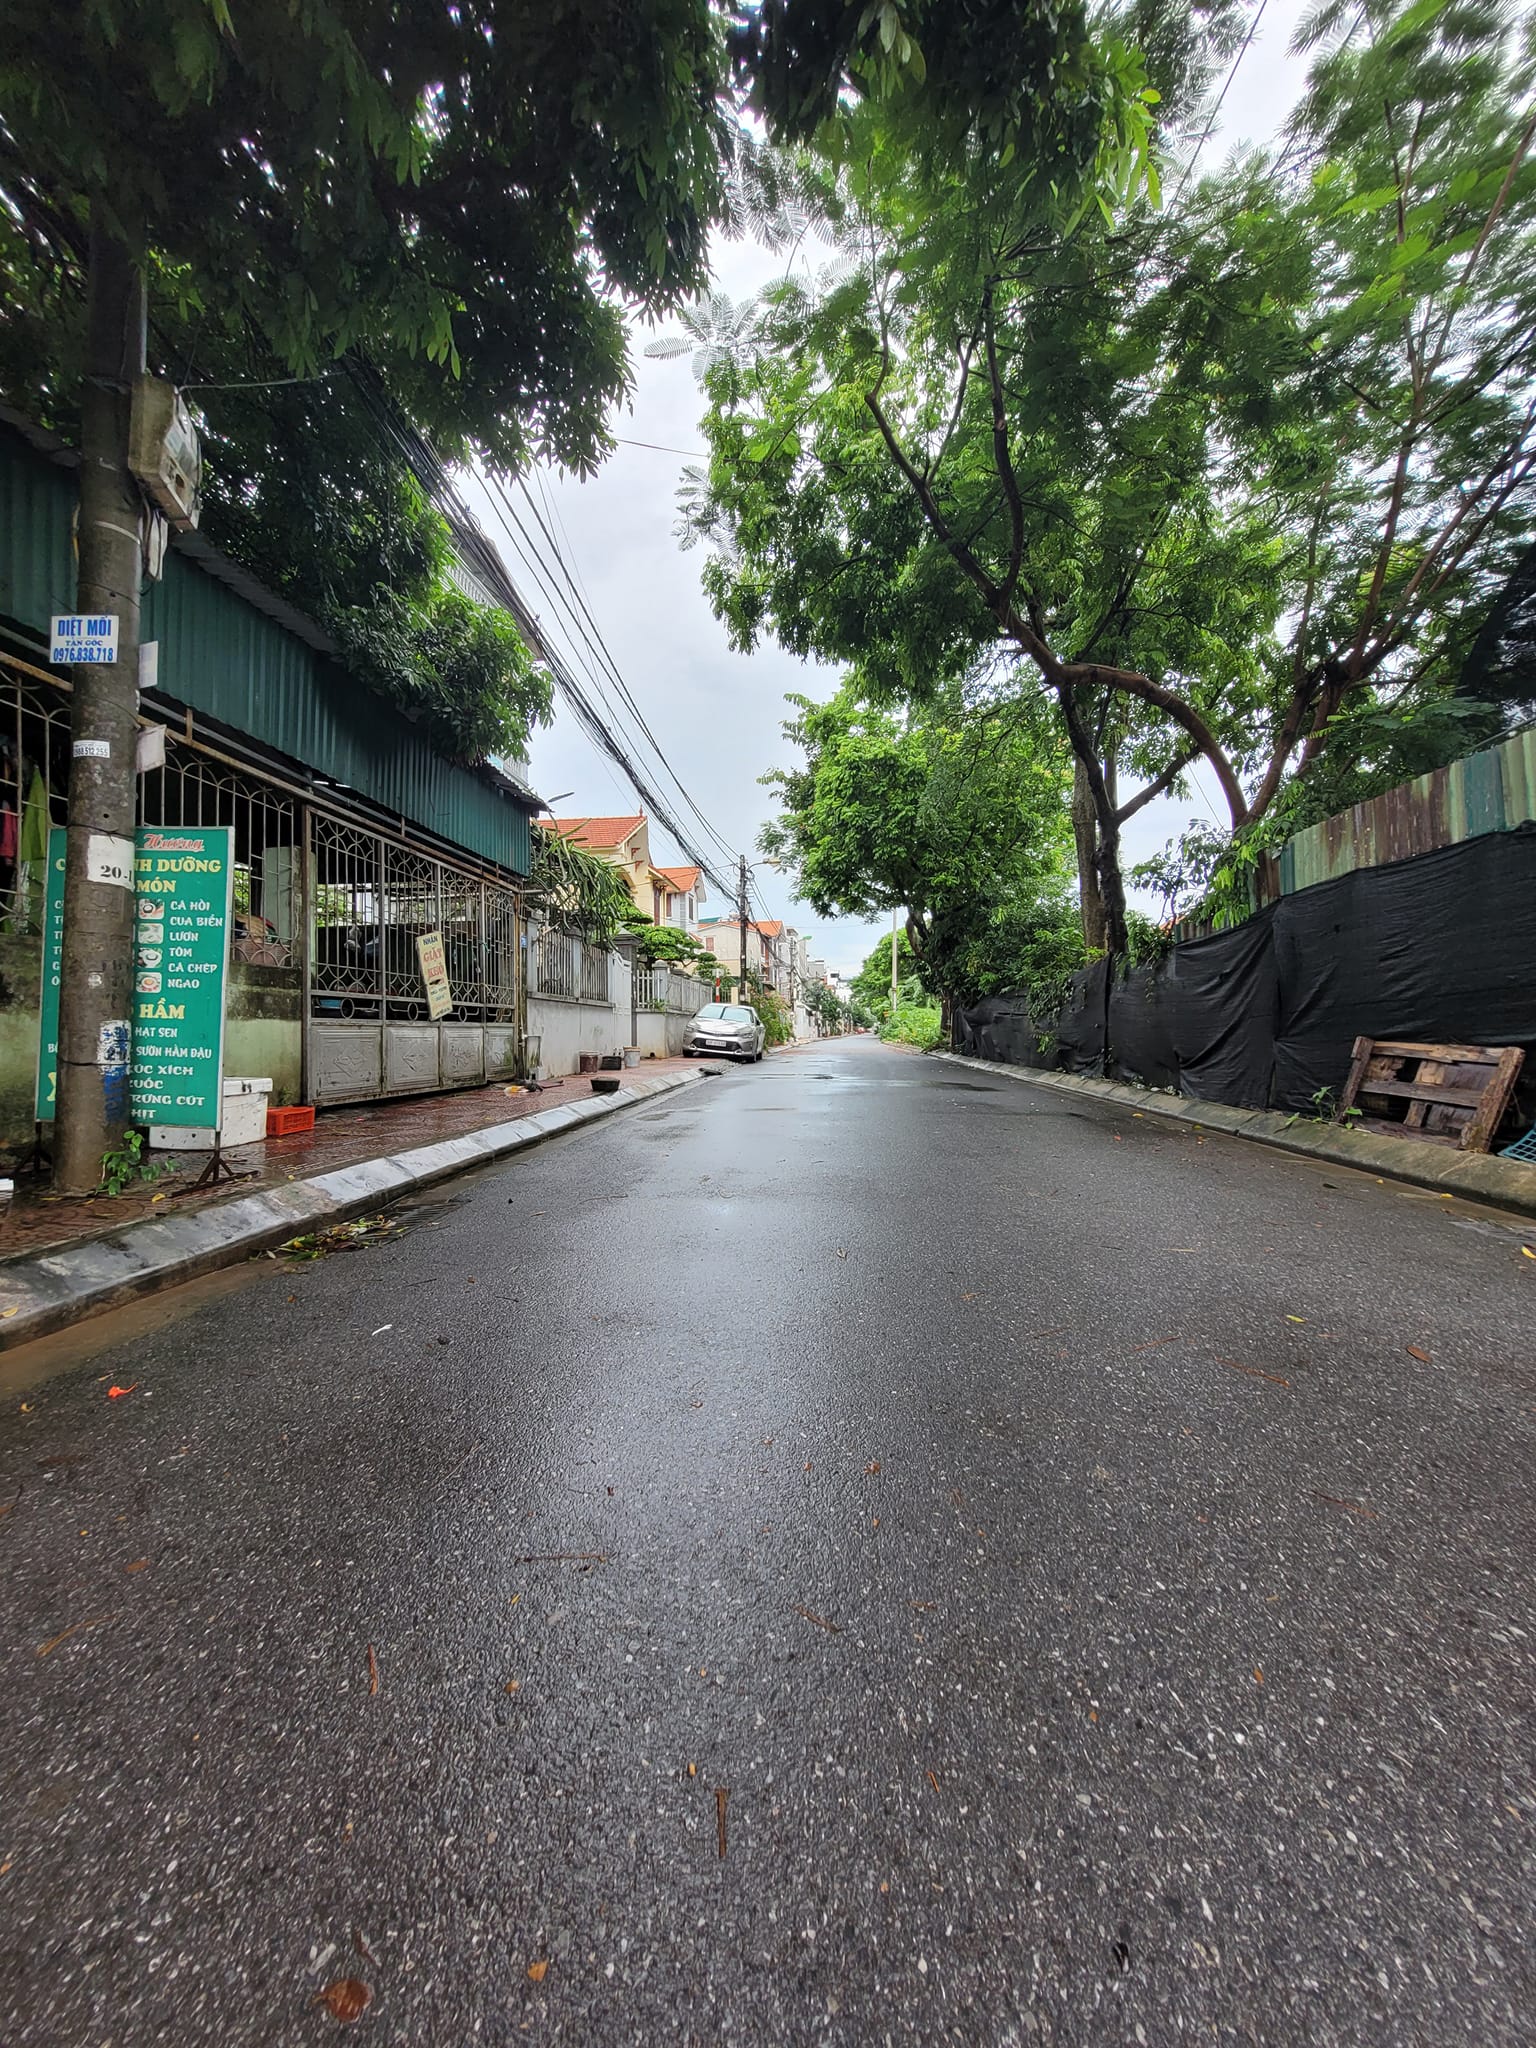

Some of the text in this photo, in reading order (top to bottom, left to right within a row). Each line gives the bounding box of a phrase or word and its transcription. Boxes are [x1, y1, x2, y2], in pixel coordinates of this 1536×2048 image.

[58, 616, 82, 637] DIỆT
[53, 647, 114, 662] 0976.838.718
[157, 856, 221, 873] DƯỠNG
[136, 877, 176, 893] MÓN
[169, 916, 193, 926] CUA
[168, 946, 193, 957] TÔM
[167, 978, 200, 989] NGAO
[139, 997, 185, 1019] HẦM
[135, 1026, 178, 1039] HẠT SEN
[157, 1065, 193, 1076] XÍCH
